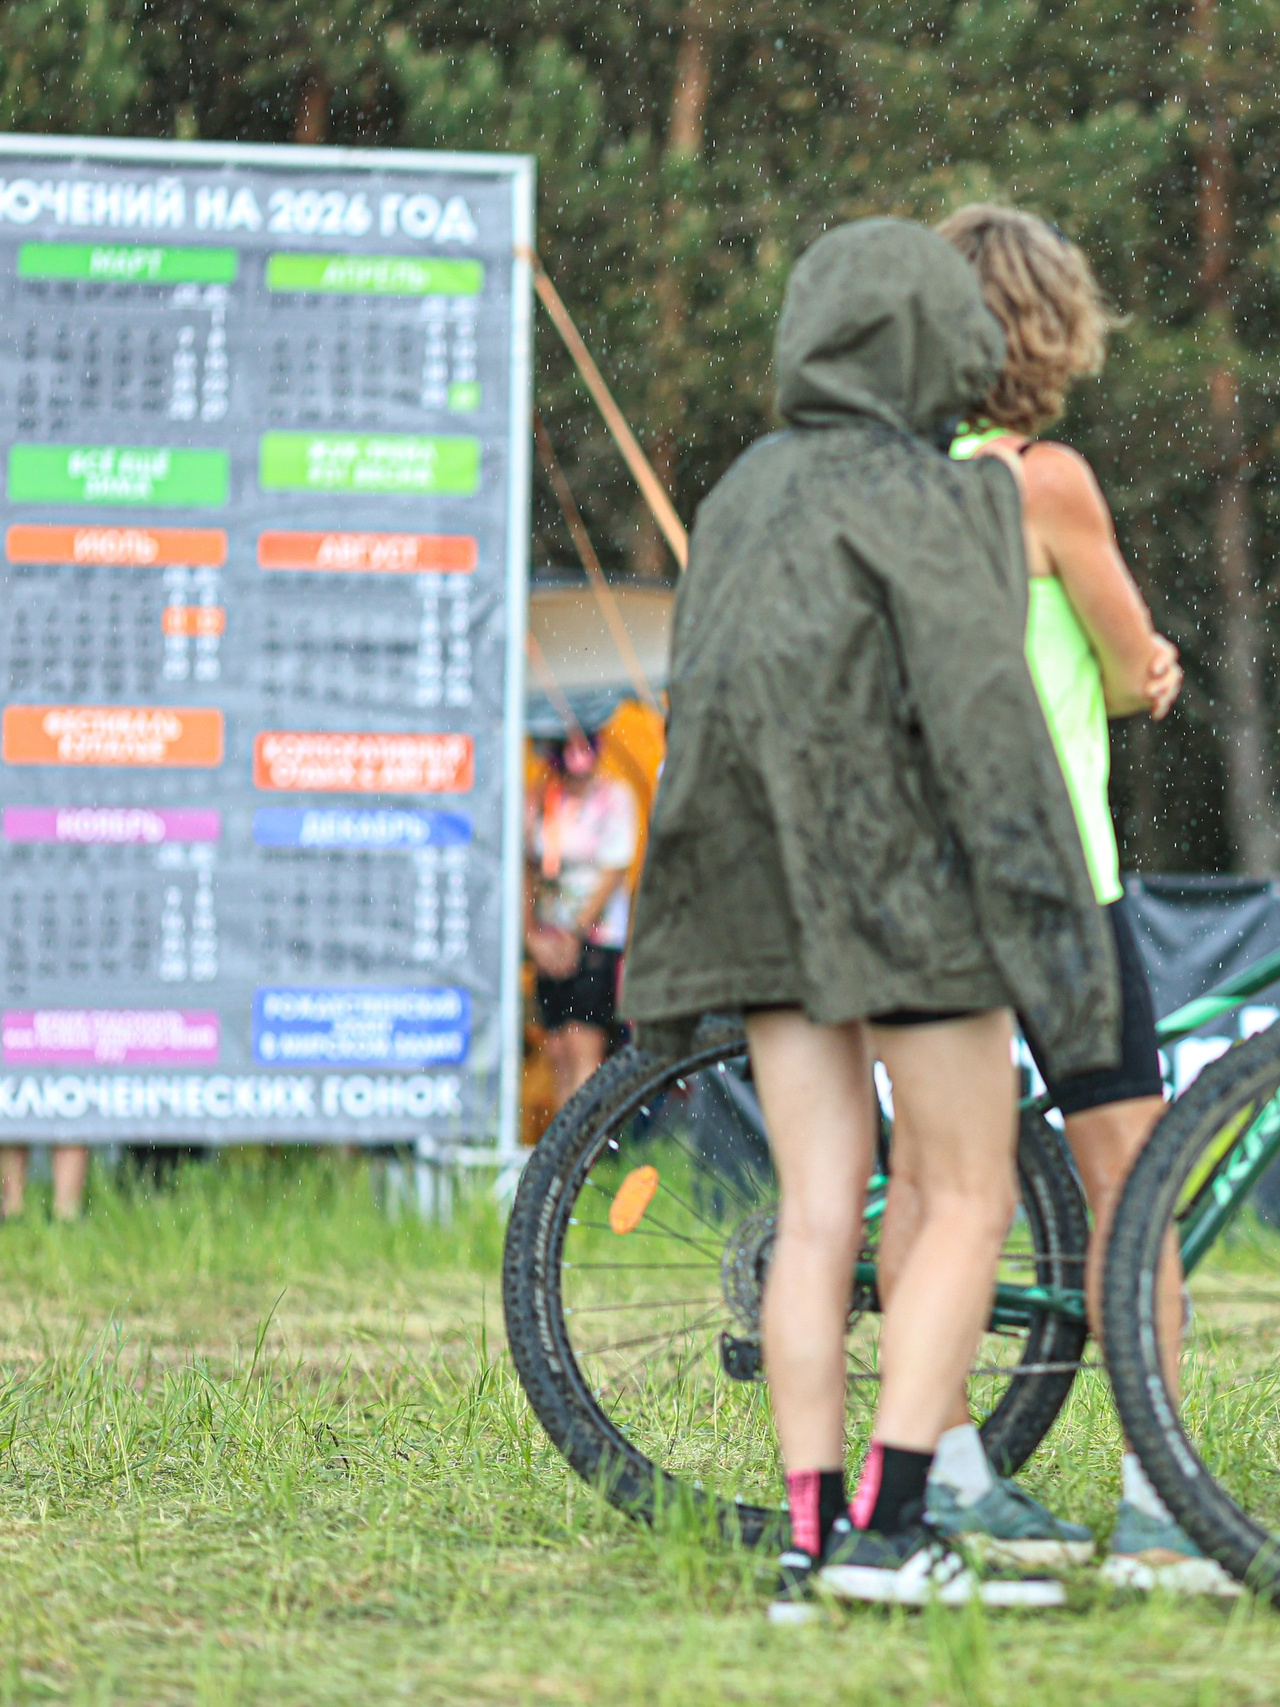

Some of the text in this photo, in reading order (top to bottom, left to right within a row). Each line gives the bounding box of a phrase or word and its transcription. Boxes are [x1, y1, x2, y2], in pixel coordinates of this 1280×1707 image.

[194, 184, 265, 233] НА
[267, 189, 374, 237] 2026
[378, 193, 478, 246] ГОД
[89, 248, 164, 279] МАРТ
[322, 262, 431, 291] АПРЕЛЬ
[74, 530, 158, 563] ИЮЛЬ
[317, 536, 420, 570] АВГУСТ
[57, 808, 166, 842] НОЯБРЬ
[302, 810, 430, 847] ДЕКАБРЬ
[321, 1075, 463, 1119] ГОНОК
